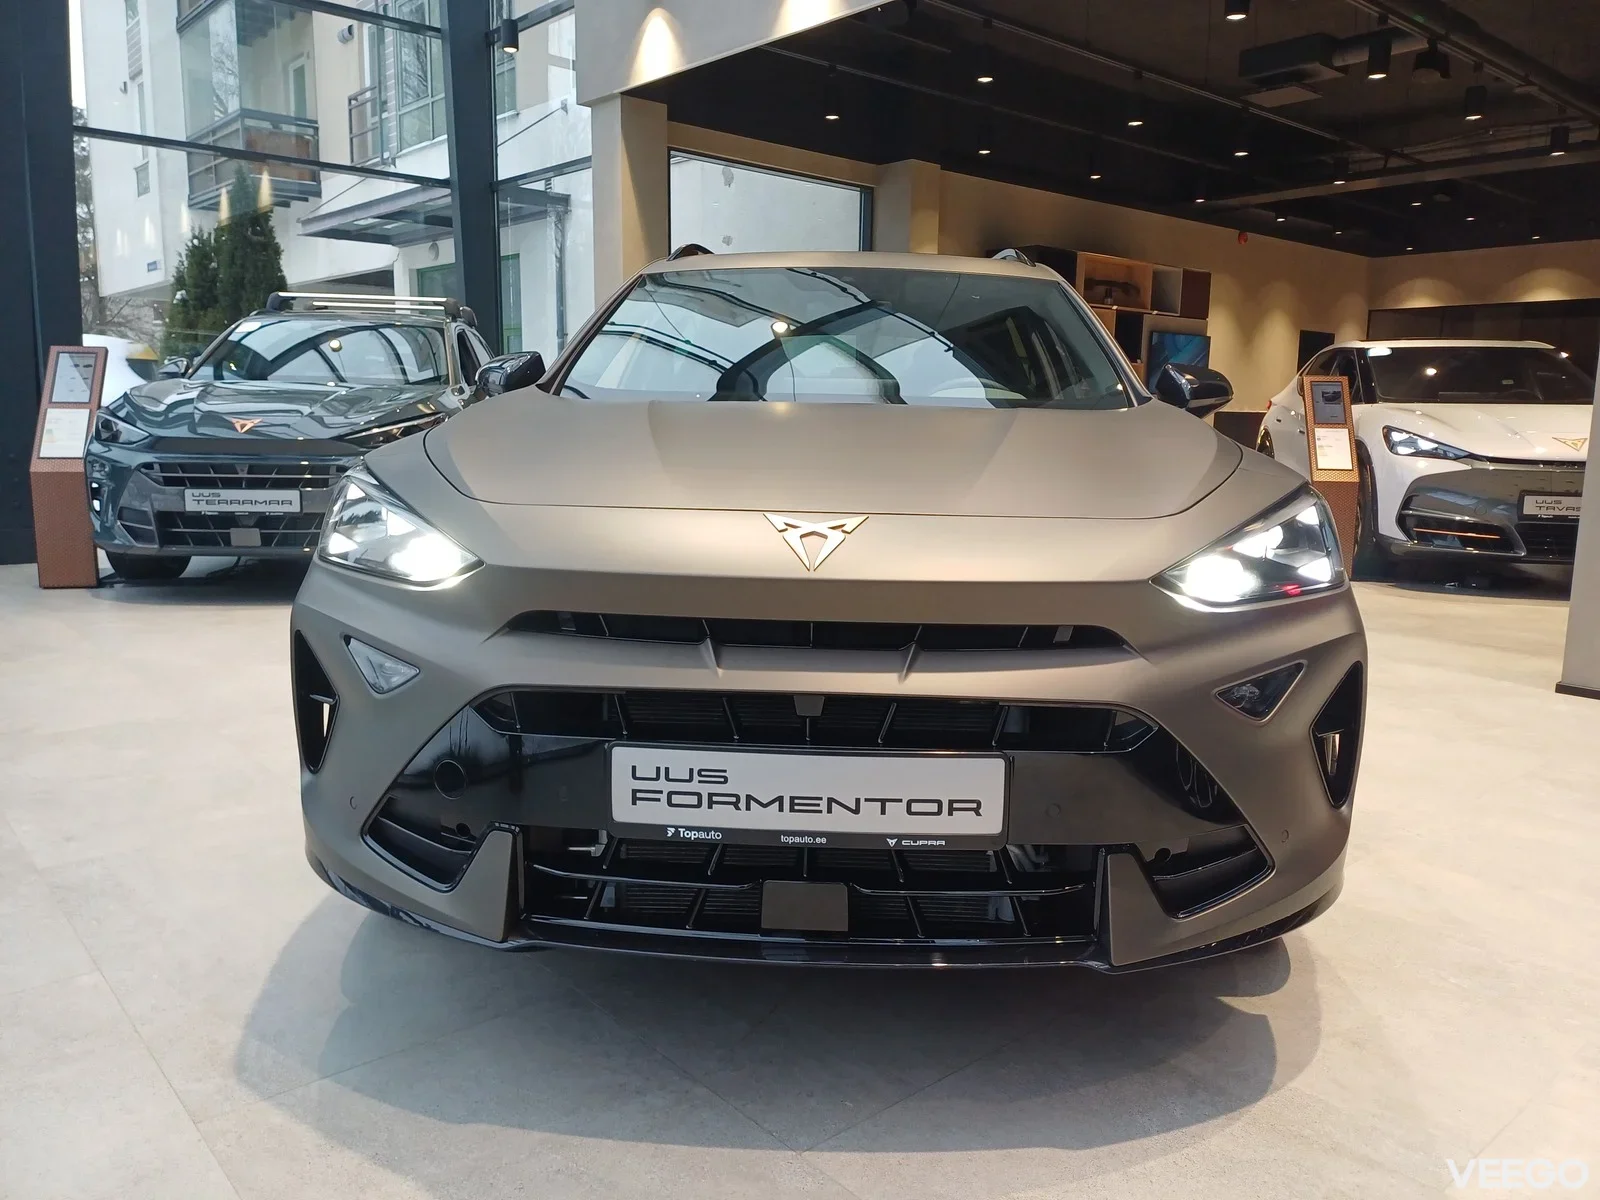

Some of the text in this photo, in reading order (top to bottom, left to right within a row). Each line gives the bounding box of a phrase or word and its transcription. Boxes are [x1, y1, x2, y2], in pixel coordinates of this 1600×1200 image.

[631, 765, 729, 785] UUS
[631, 788, 983, 817] FORMENTOR
[678, 828, 722, 841] Topauto
[780, 834, 827, 845] topauto.ee
